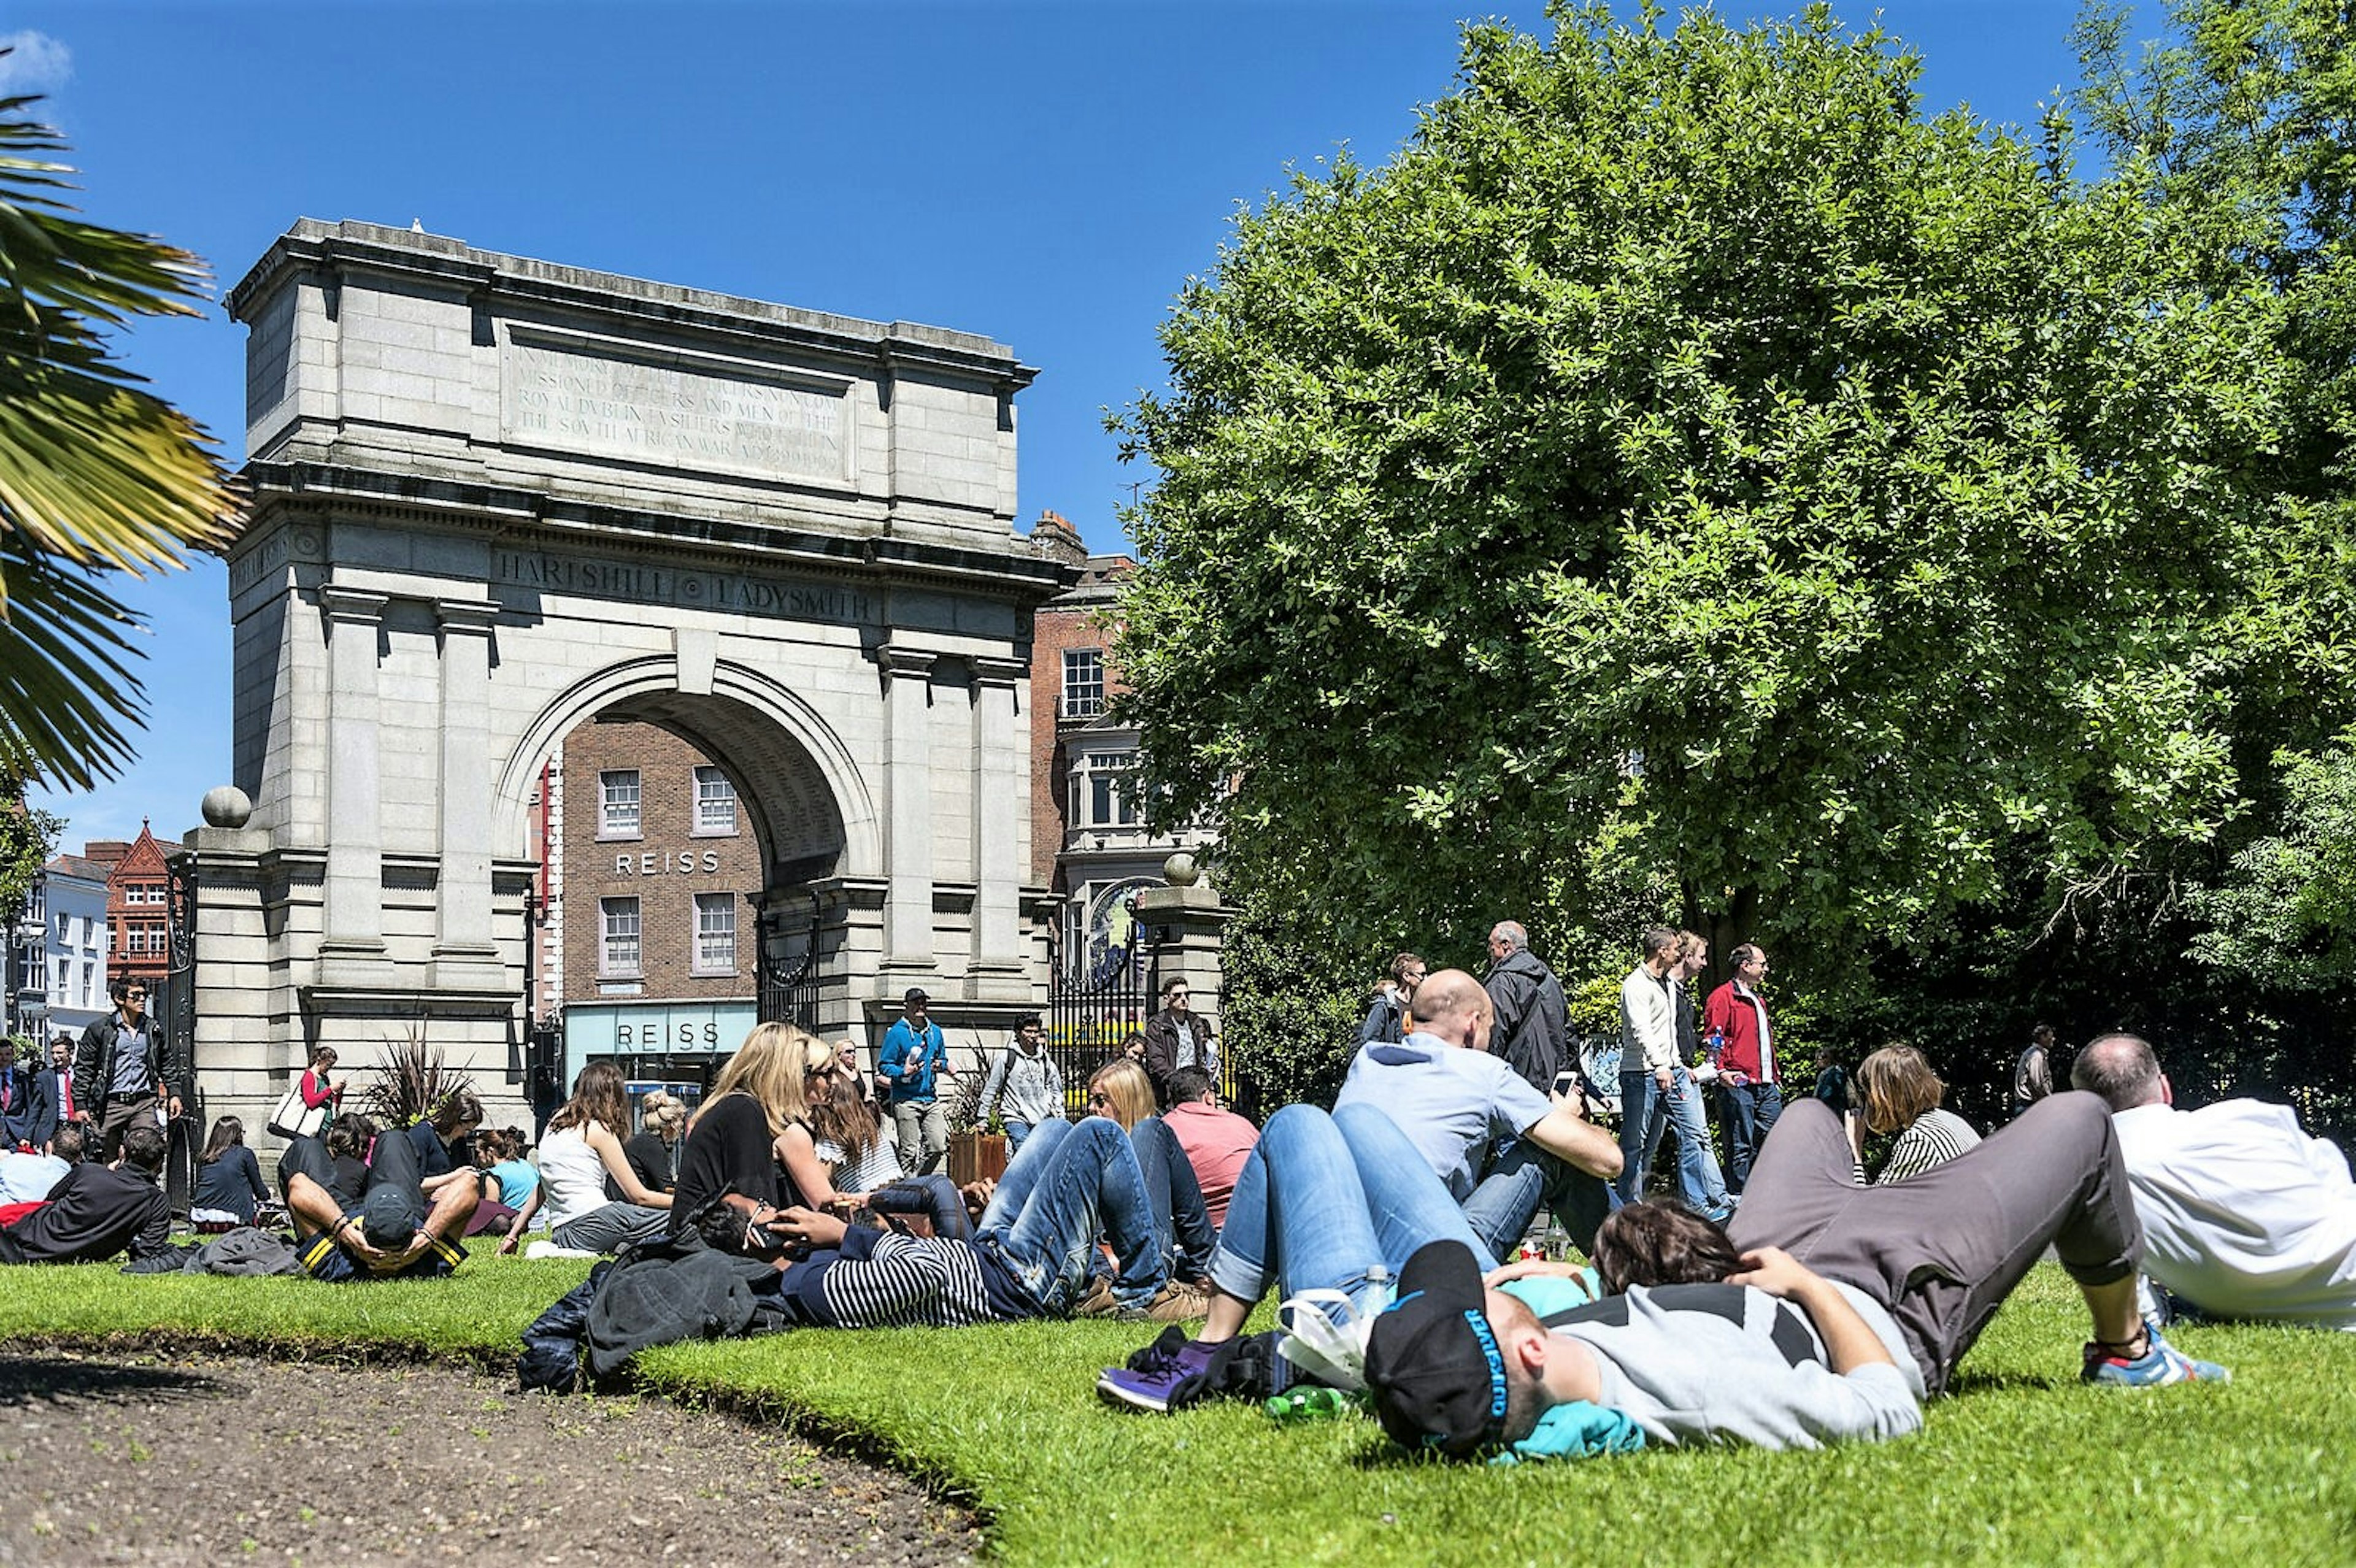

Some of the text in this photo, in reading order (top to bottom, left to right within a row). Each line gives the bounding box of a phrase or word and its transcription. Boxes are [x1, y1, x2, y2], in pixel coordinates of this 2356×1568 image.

[502, 554, 868, 620] HARTSHILL LADYSMITH
[616, 851, 719, 874] REISS
[617, 1024, 718, 1044] REISS
[1464, 1309, 1507, 1417] QUIKSILVER
